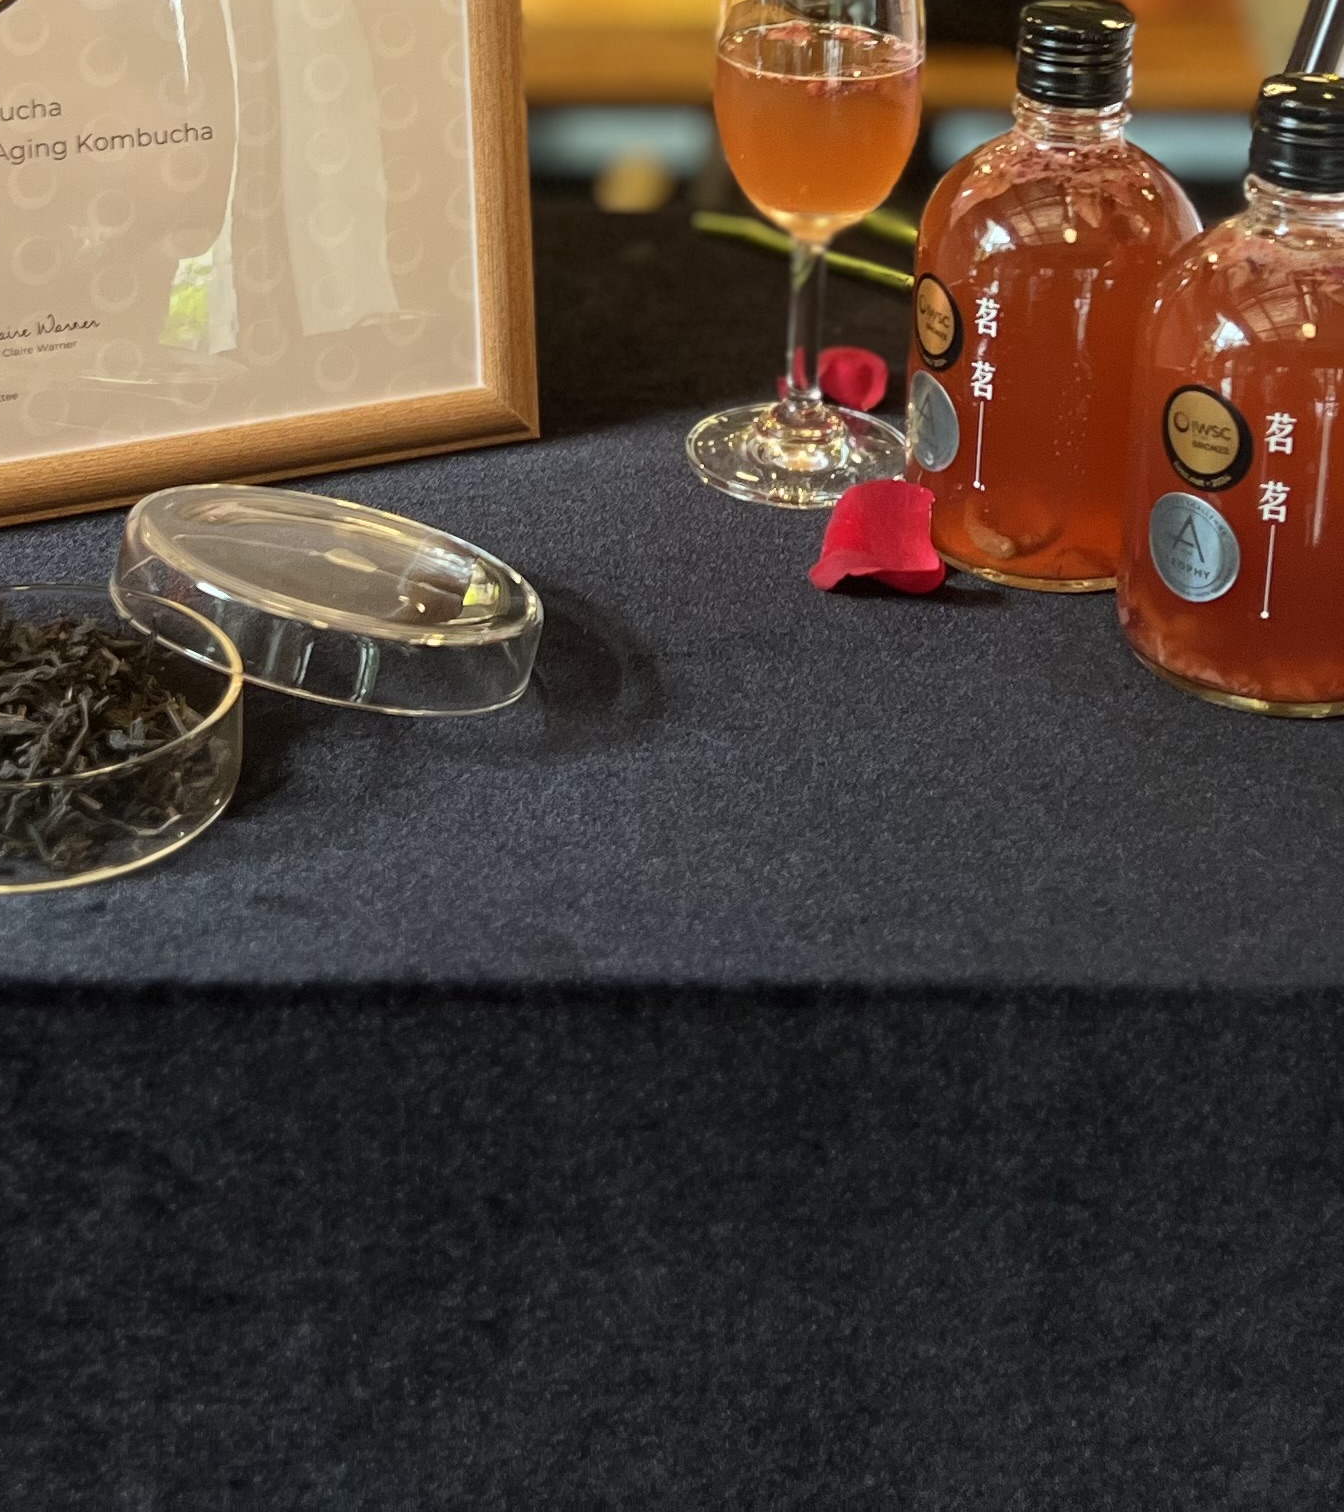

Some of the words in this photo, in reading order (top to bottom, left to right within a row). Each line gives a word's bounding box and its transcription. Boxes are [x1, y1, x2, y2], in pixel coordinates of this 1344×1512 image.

[75, 121, 215, 156] Kombucha
[1, 344, 34, 359] Claire
[37, 339, 78, 355] Warner
[969, 297, 1001, 402] 茗茗
[1191, 420, 1232, 441] IWSC
[1257, 411, 1298, 524] 茗茗
